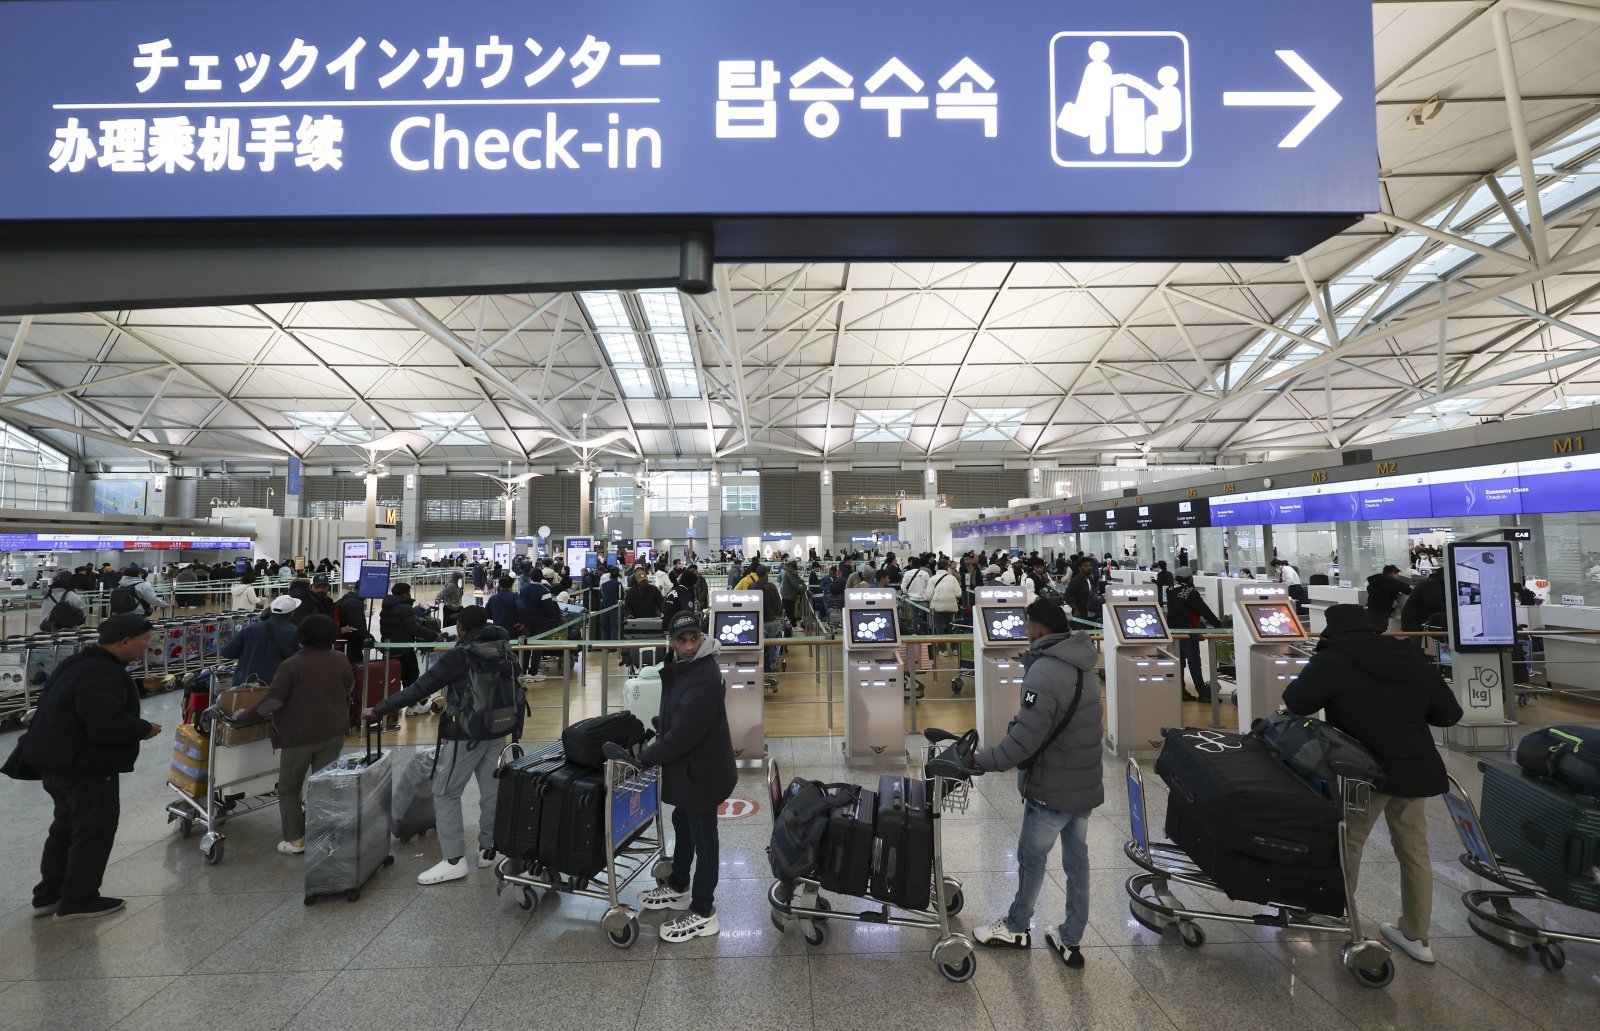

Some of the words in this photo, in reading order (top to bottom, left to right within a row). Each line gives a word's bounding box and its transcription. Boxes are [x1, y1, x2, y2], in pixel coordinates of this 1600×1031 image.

[132, 35, 661, 93] チェックインカウンター
[716, 56, 998, 138] 탑승수속
[48, 114, 344, 174] 办理乘机手续
[389, 112, 662, 170] Check-in
[1553, 436, 1584, 454] M1
[1377, 462, 1397, 474] M2
[1311, 472, 1327, 482] M3
[387, 509, 396, 523] M
[994, 590, 1023, 598] Check-in
[1025, 693, 1035, 703] M
[1472, 688, 1488, 701] kg
